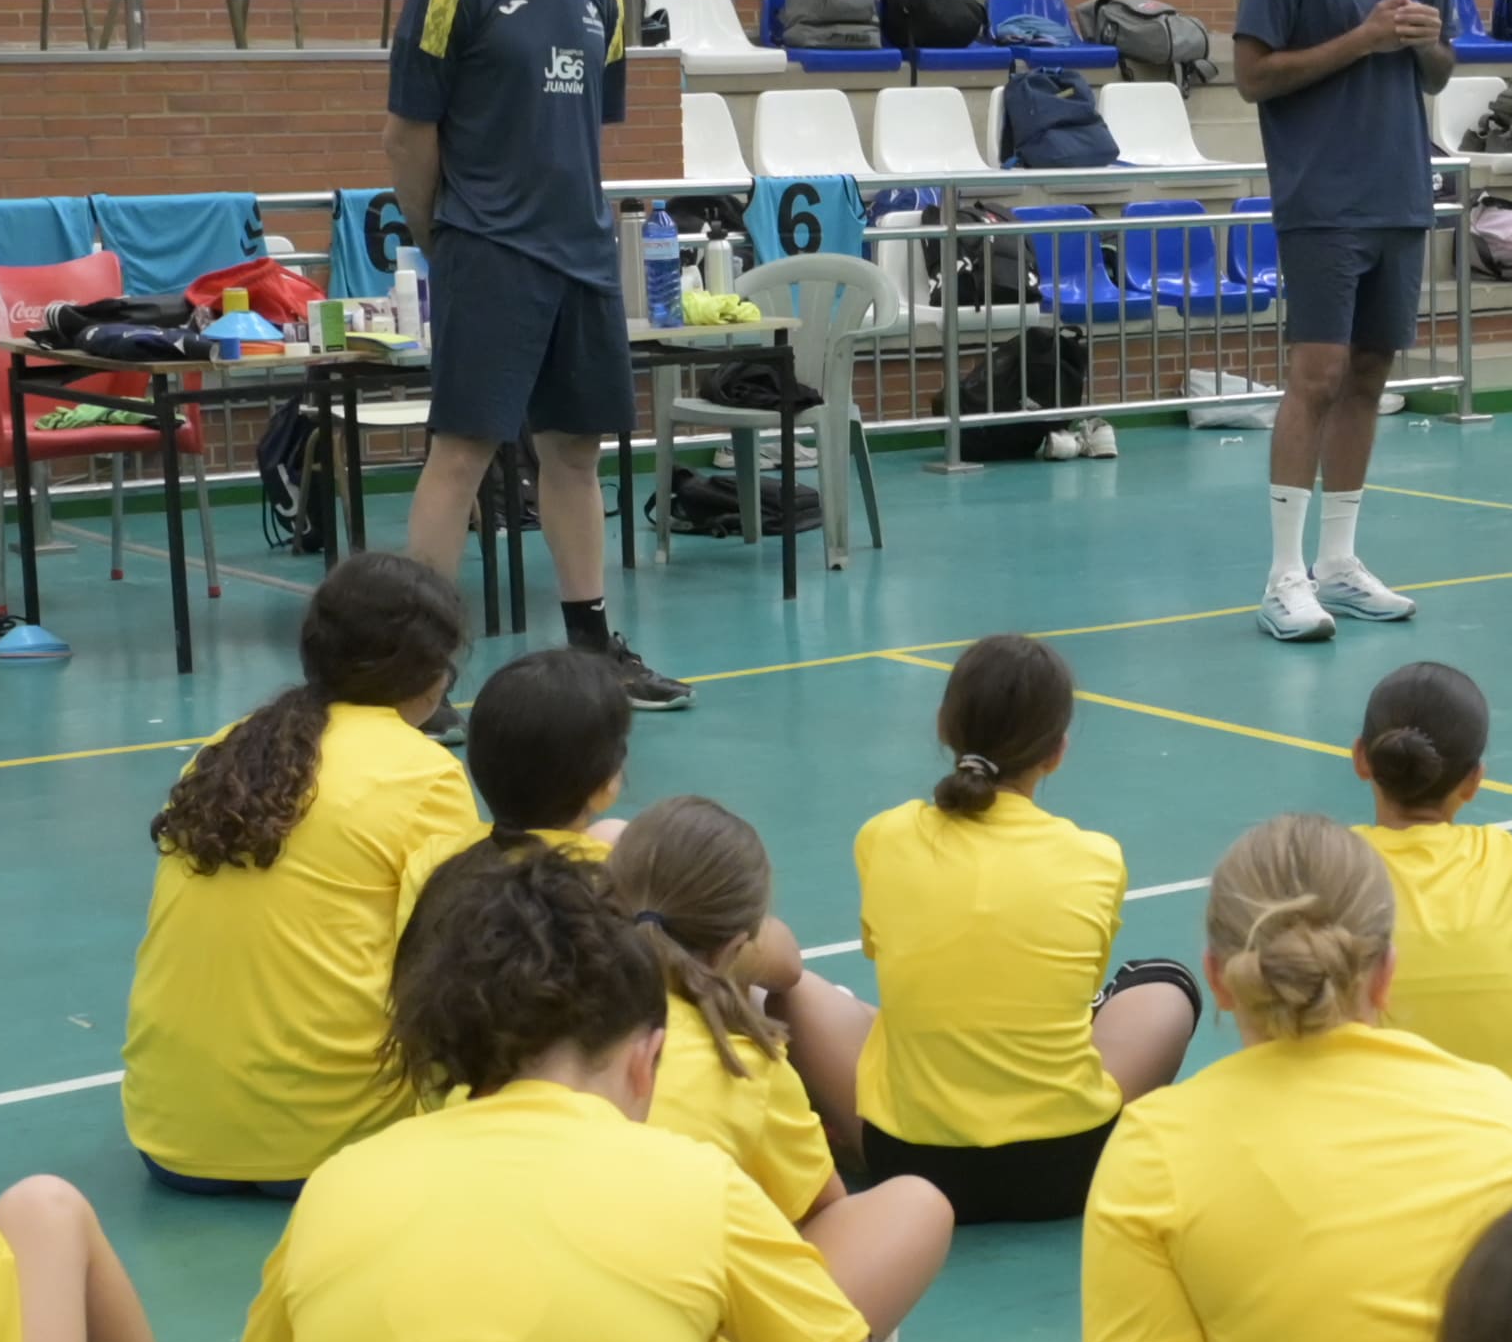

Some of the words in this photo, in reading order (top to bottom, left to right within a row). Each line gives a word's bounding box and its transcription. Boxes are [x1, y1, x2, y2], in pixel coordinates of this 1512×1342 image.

[544, 46, 585, 81] JG6
[364, 191, 415, 274] 6
[777, 182, 822, 256] 6
